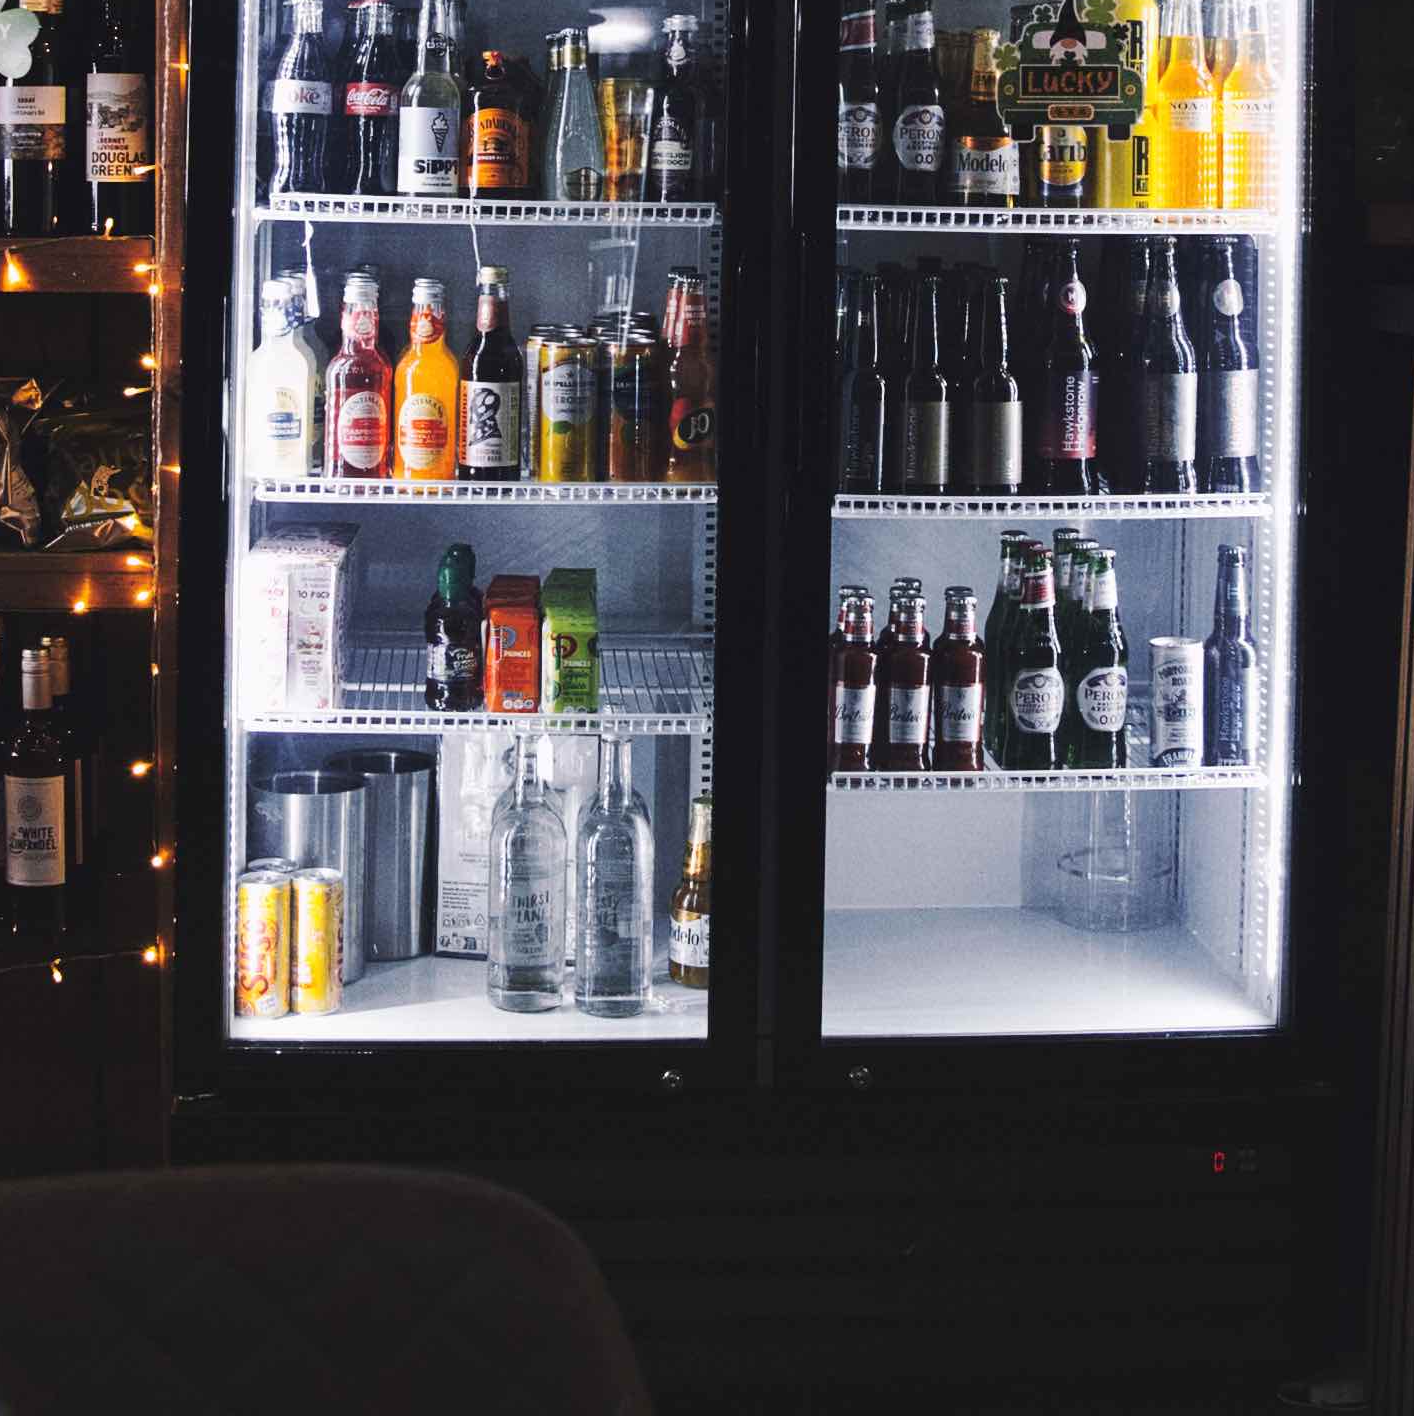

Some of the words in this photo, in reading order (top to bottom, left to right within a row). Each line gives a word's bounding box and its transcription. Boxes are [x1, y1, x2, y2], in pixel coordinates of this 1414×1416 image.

[838, 125, 879, 140] PERON
[899, 126, 943, 142] PERON
[91, 152, 147, 164] DOUGLAS
[91, 164, 133, 176] GREEN
[1062, 374, 1076, 452] Hawkstone
[1084, 689, 1128, 704] PERON
[18, 827, 55, 839] WHITE
[674, 925, 700, 945] delo
